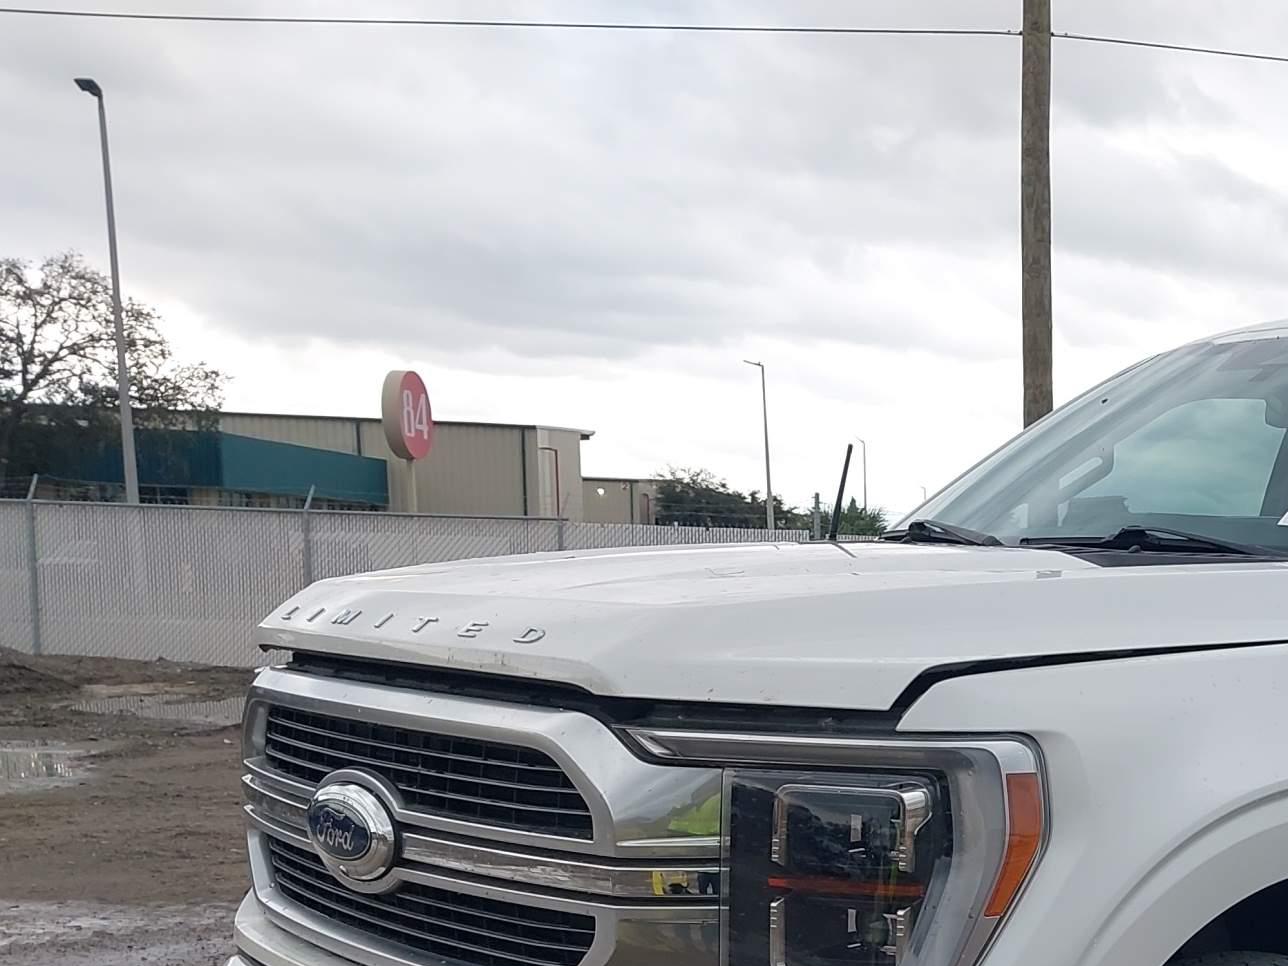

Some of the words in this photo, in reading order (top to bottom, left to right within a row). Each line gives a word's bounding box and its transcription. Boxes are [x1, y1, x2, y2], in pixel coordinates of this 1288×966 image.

[402, 389, 429, 440] 84
[281, 606, 546, 644] LIMITED
[316, 807, 355, 851] Ford
